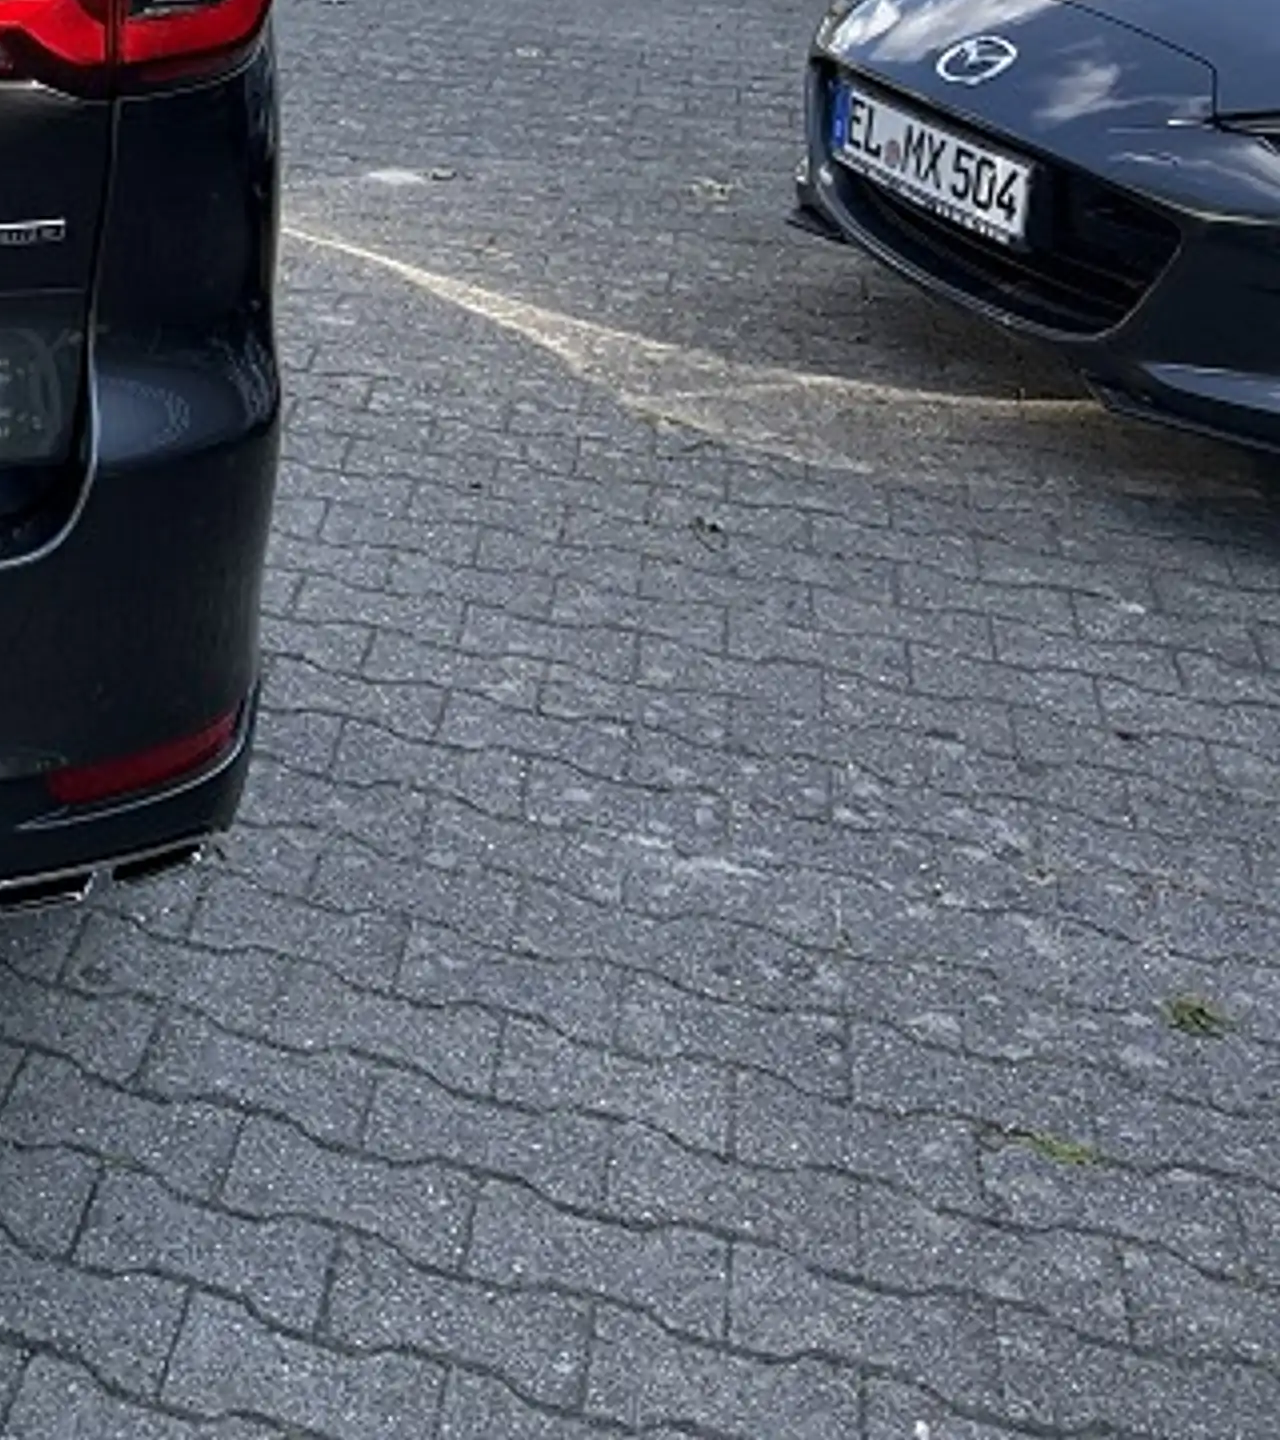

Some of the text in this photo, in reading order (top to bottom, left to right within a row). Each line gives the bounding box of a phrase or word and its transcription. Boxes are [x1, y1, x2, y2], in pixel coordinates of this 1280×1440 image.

[848, 97, 882, 158] EL
[901, 124, 947, 191] MX
[951, 146, 1020, 222] 504
